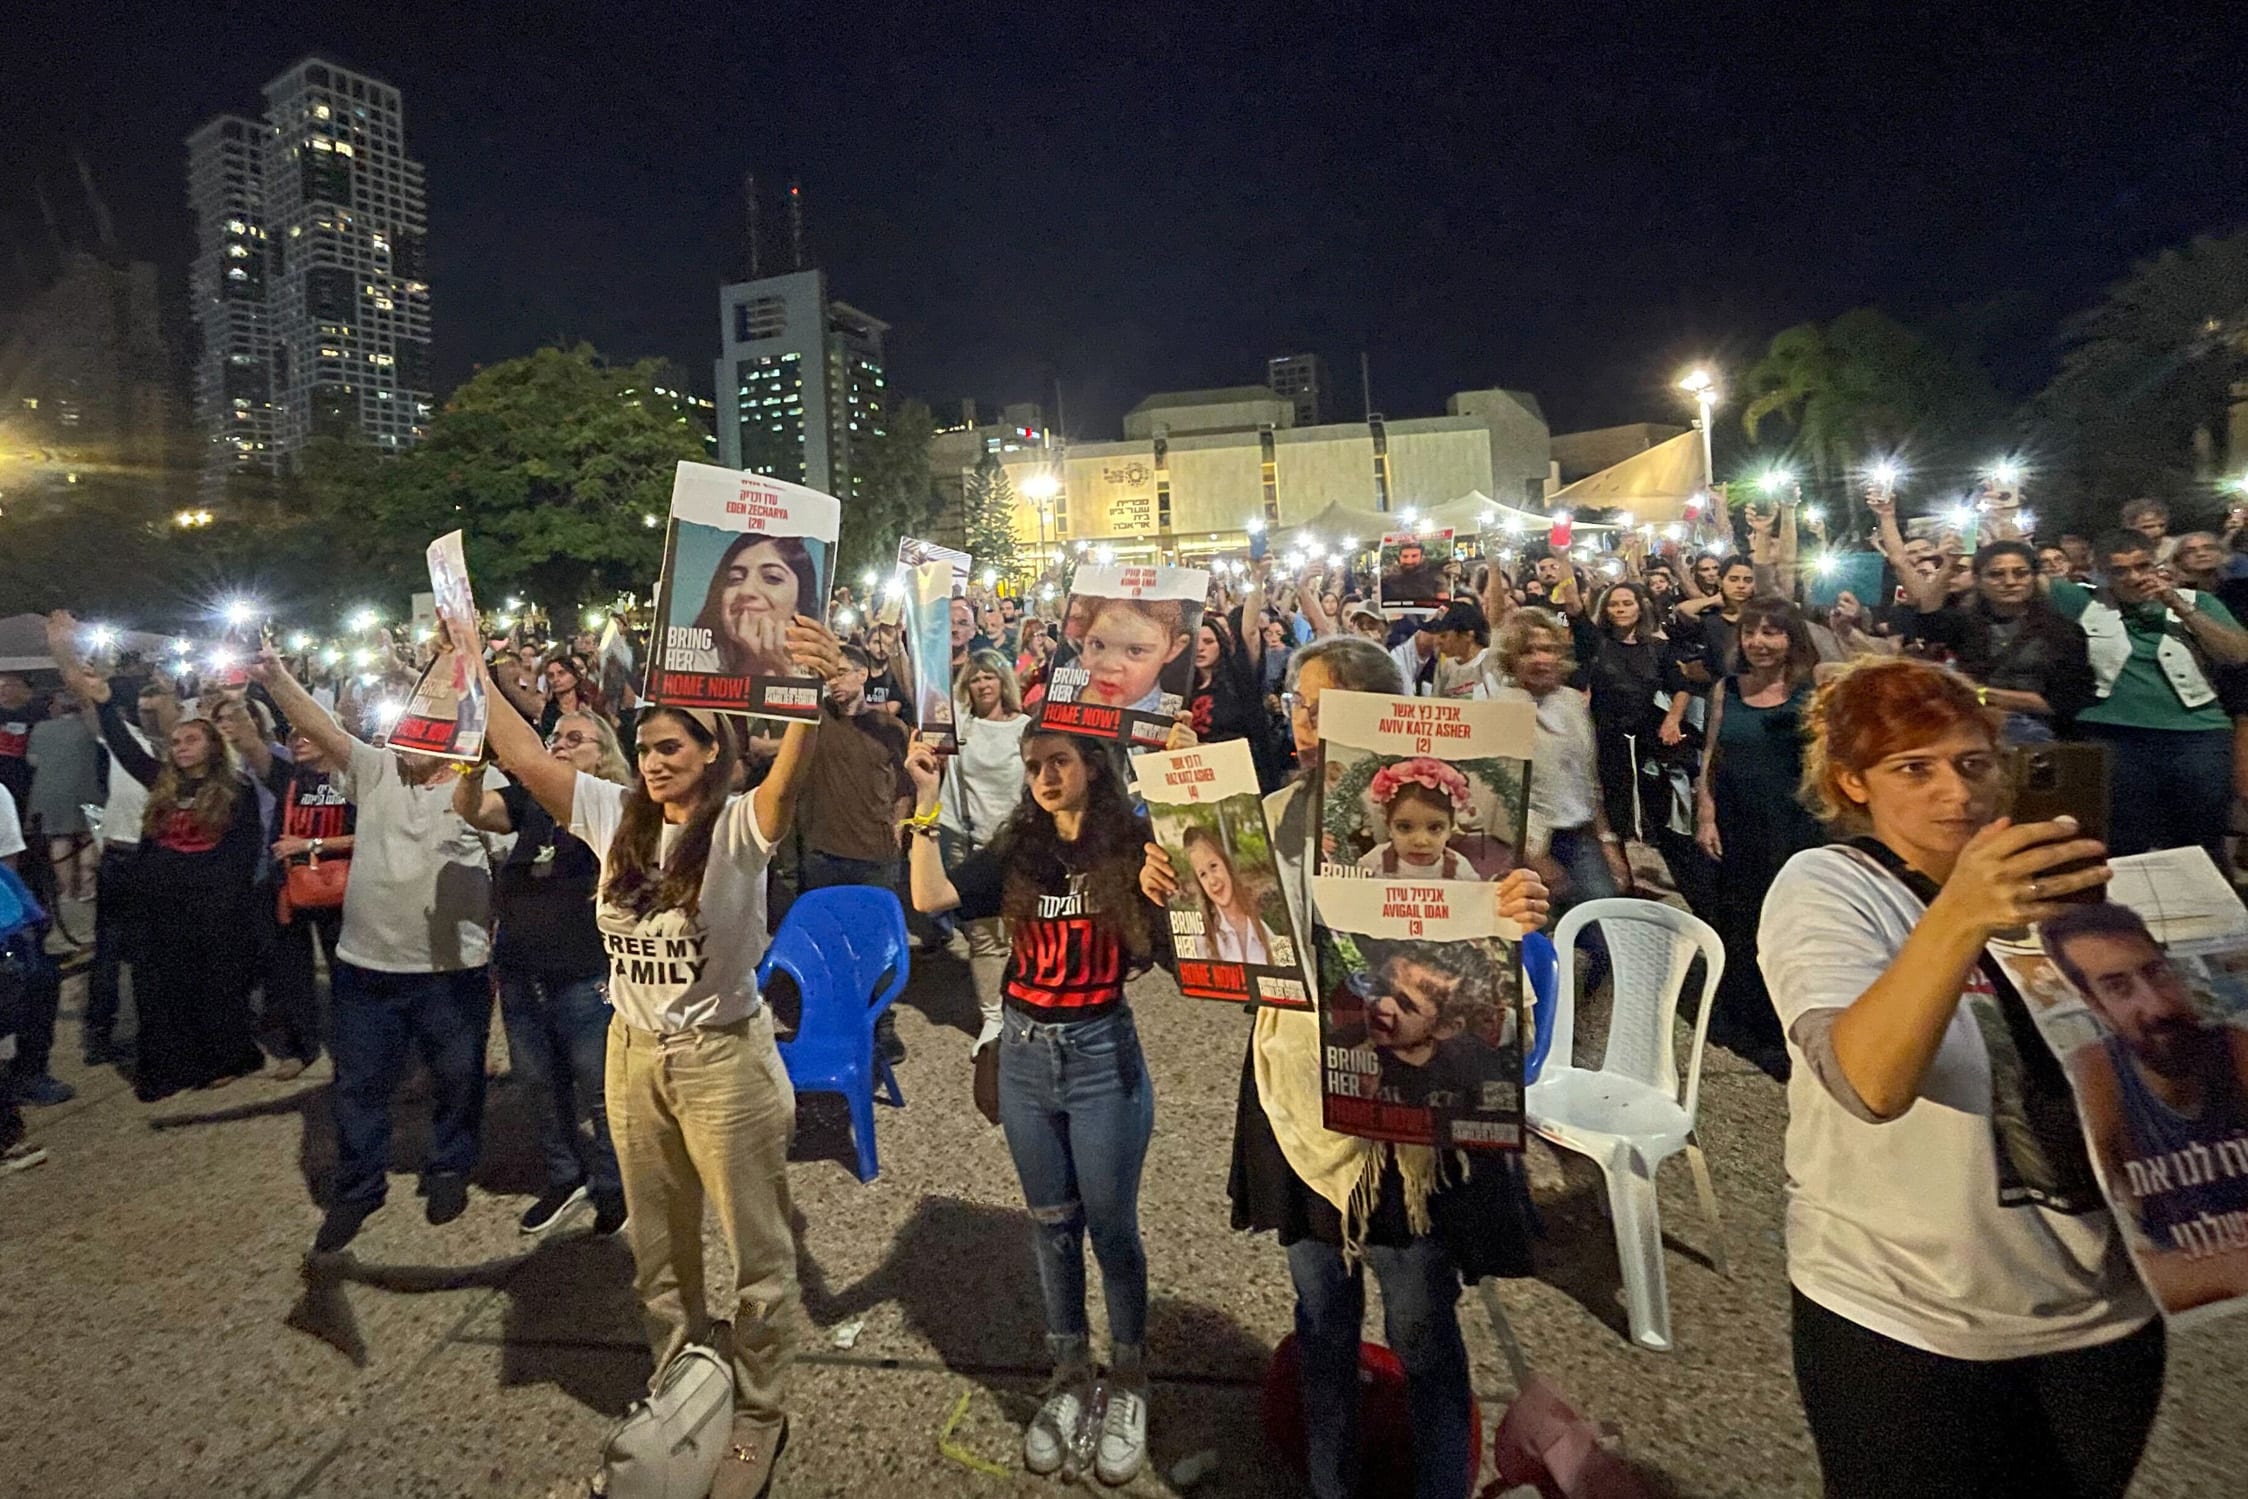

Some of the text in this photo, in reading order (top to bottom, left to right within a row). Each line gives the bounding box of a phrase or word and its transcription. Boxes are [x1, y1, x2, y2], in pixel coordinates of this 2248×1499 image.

[726, 502, 788, 521] EDEN ZECHARYA
[667, 626, 713, 650] BRING
[664, 649, 694, 671] HER
[663, 674, 707, 696] HOME
[707, 676, 750, 699] NOW!
[1052, 667, 1091, 687] BRING
[1048, 684, 1075, 703] HER
[1043, 703, 1121, 730] HOME NOW!
[1391, 702, 1461, 721] אביב כץ אשר
[1379, 718, 1471, 739] AVIV KATZ ASHER
[1416, 737, 1431, 754] (2)
[1385, 887, 1444, 903] אביגיל עידן
[1169, 910, 1205, 935] BRING
[1382, 903, 1449, 920] AVIGAIL IDAN
[1409, 920, 1423, 937] (3)
[602, 933, 710, 958] REE MY
[1173, 935, 1198, 959] HER
[608, 954, 710, 985] AMILY
[1179, 962, 1213, 987] HOME
[1327, 1046, 1380, 1076] BRING
[1328, 1070, 1361, 1098] HER
[2124, 1156, 2175, 1197] את
